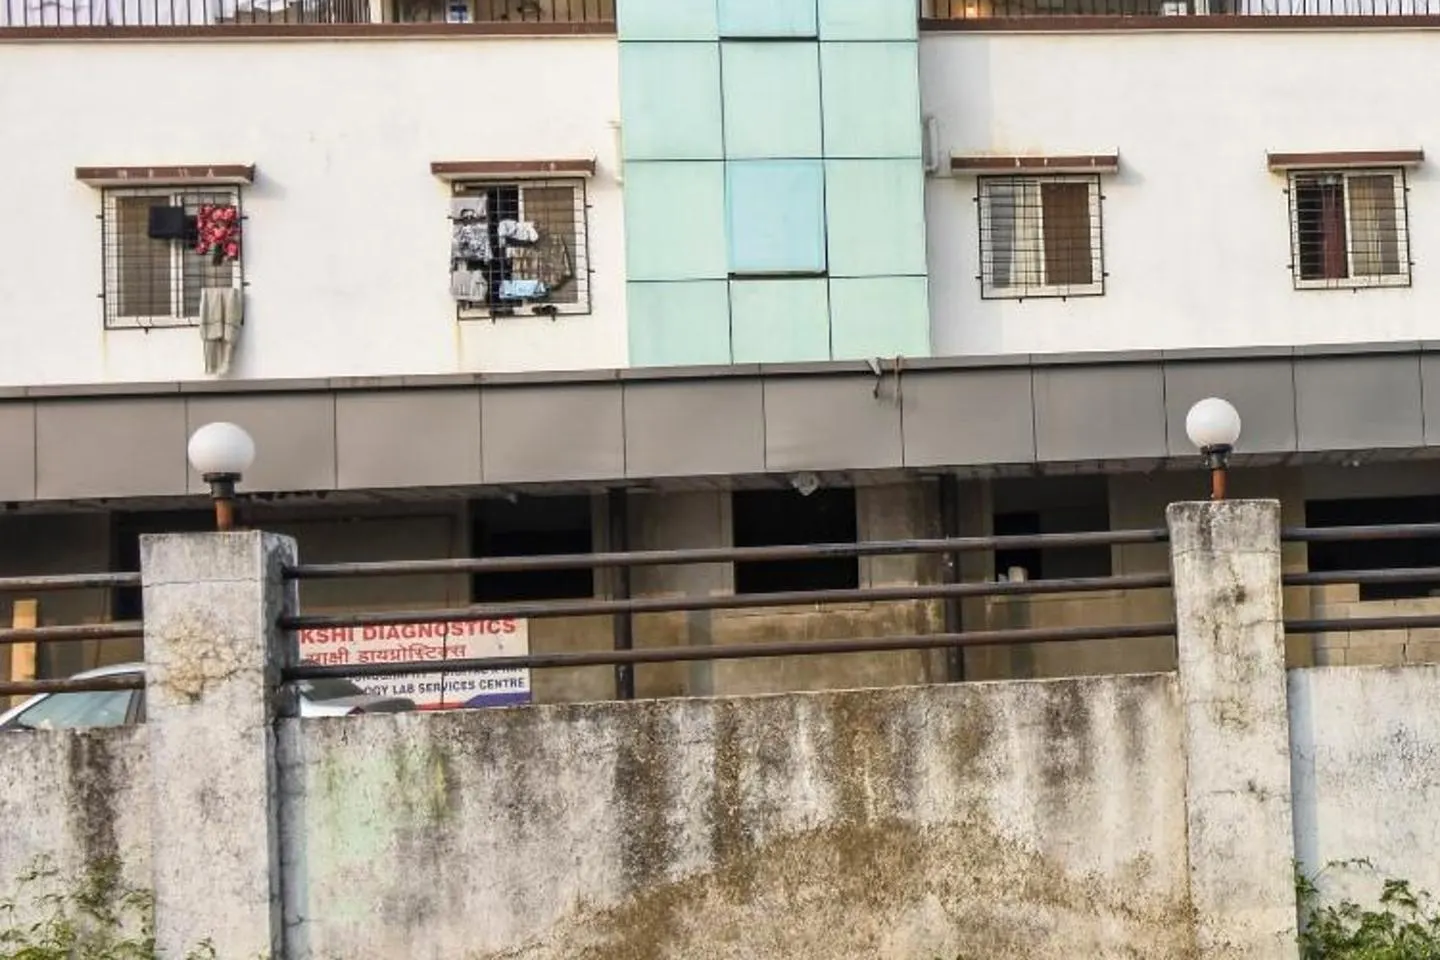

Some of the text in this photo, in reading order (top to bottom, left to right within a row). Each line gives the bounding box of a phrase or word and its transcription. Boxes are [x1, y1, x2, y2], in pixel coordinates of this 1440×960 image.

[363, 618, 516, 641] DIAGNOSTICS
[393, 683, 414, 695] LAB
[418, 680, 476, 694] SERVICES
[479, 677, 525, 691] CENTRE
